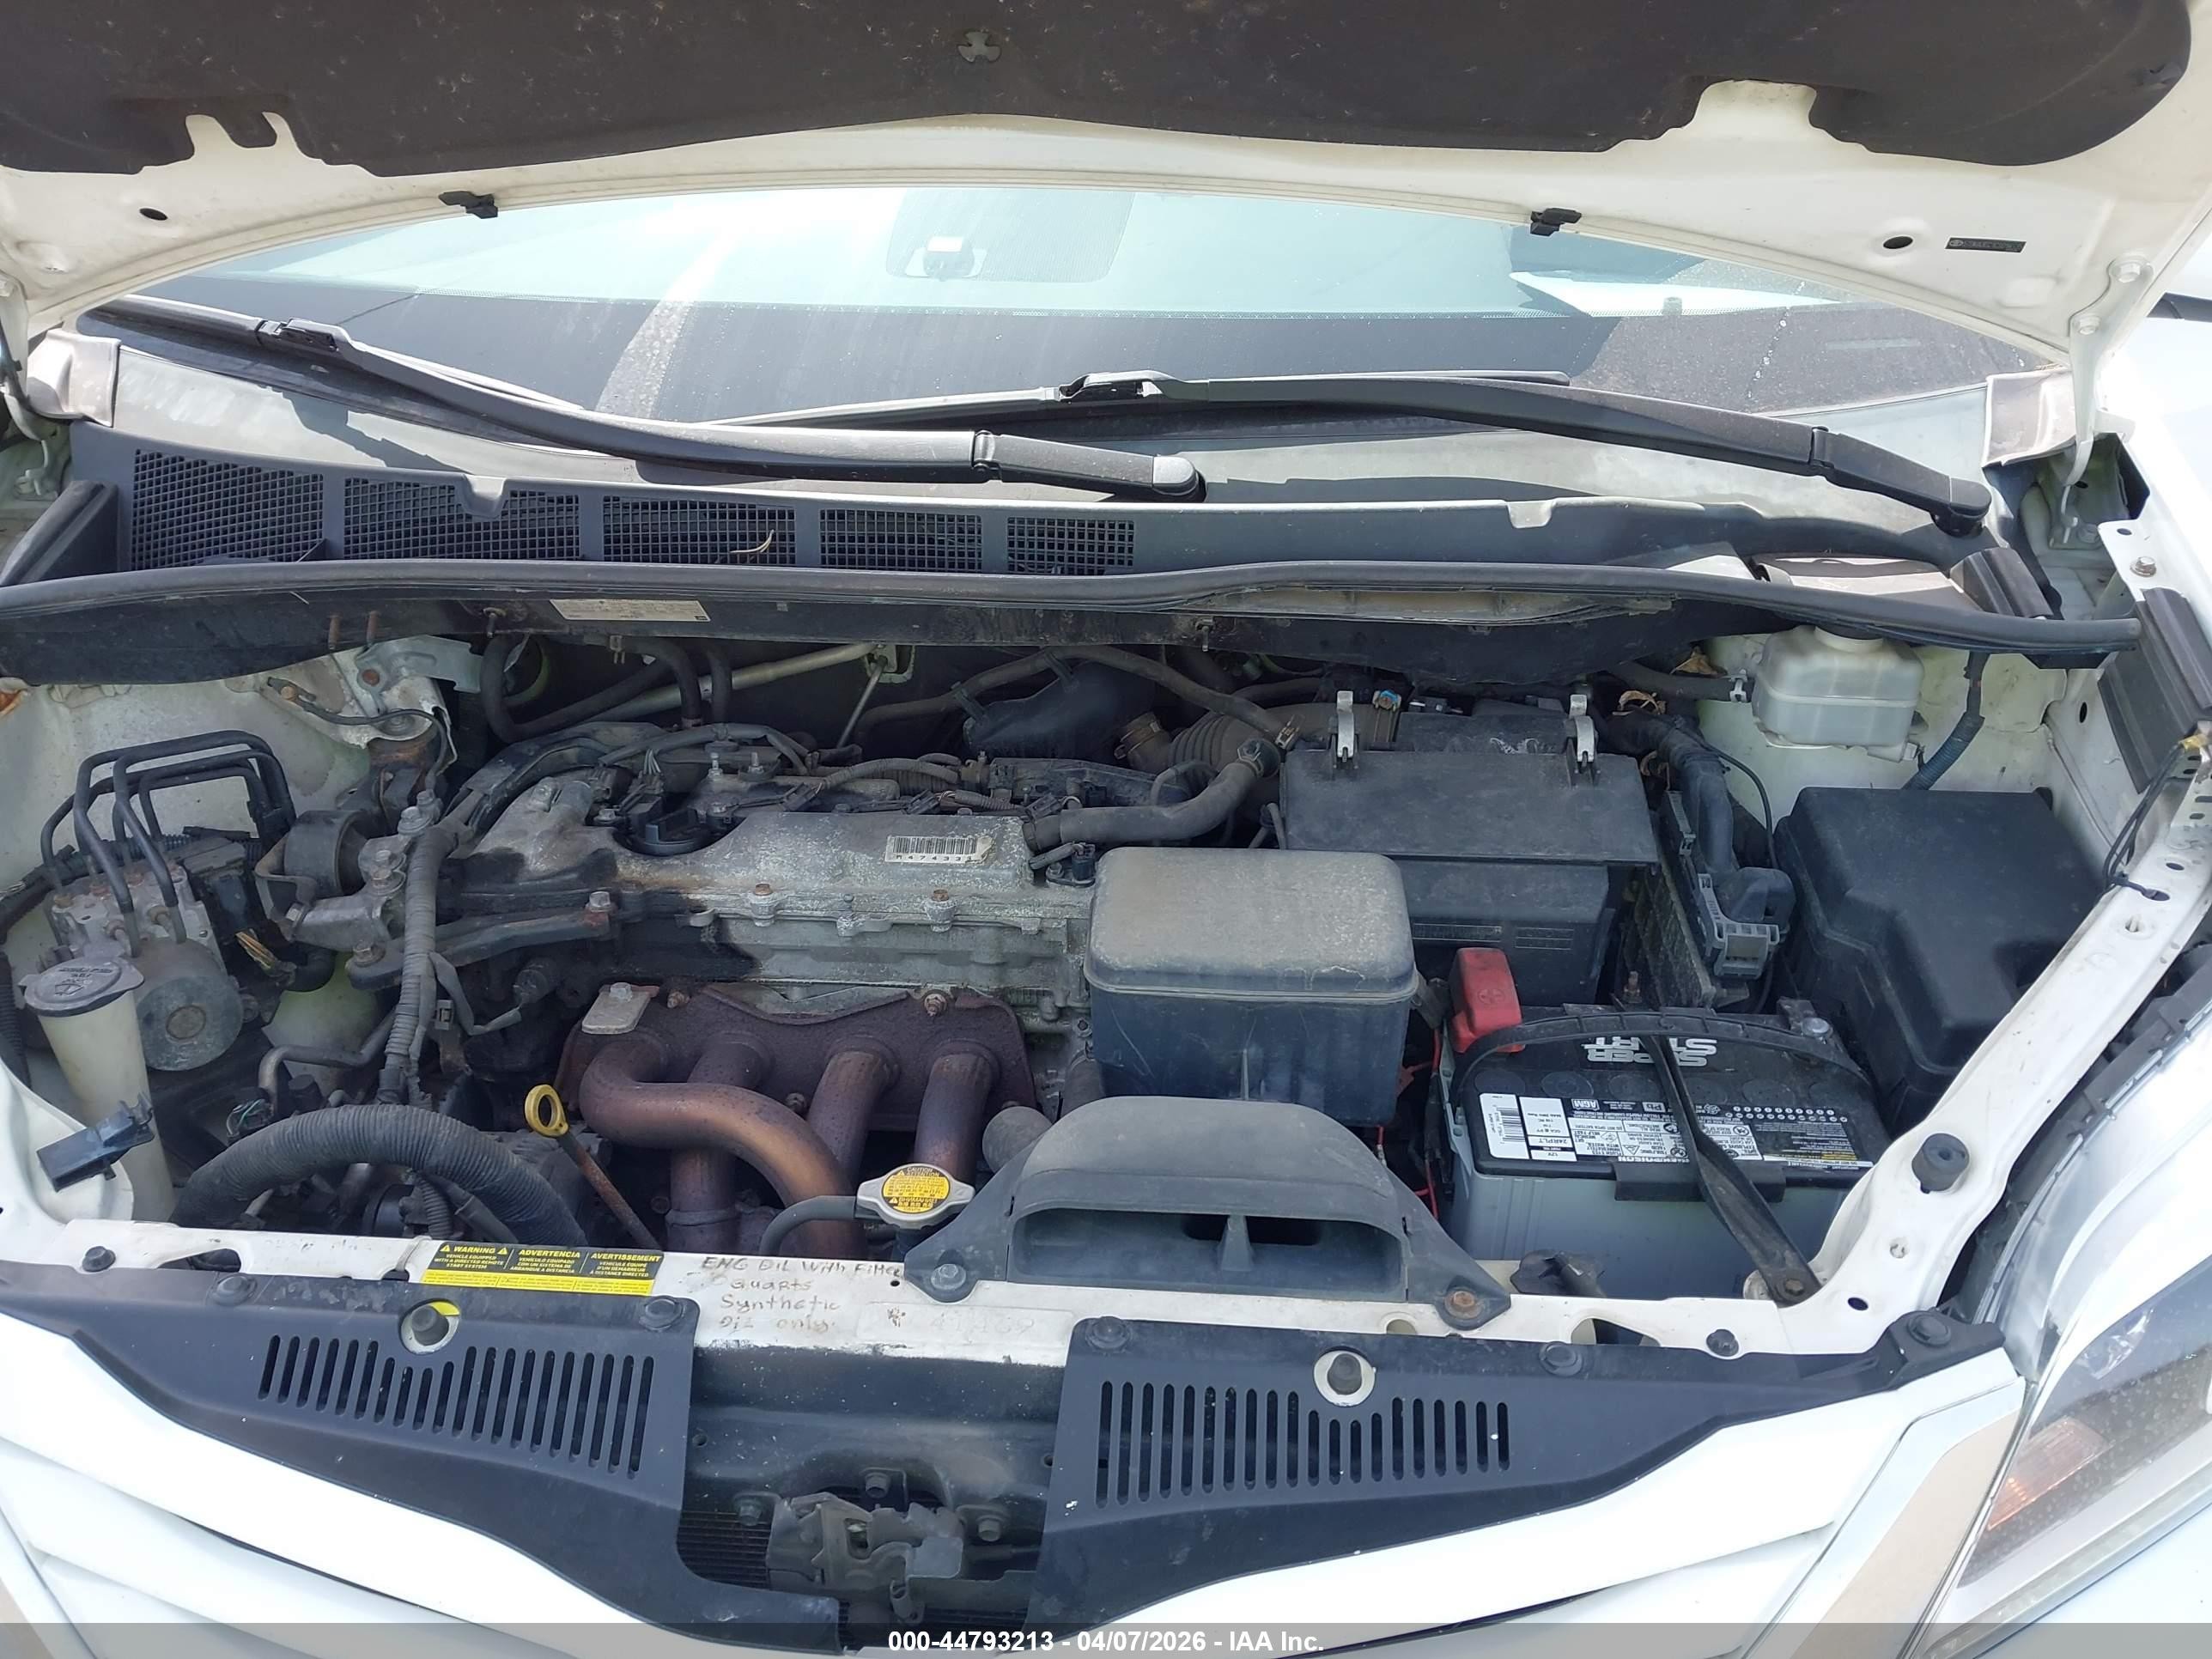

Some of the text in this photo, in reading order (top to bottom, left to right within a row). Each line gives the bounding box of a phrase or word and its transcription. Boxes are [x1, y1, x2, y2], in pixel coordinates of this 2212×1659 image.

[1582, 1036, 1717, 1055] STRT
[1588, 1049, 1708, 1066] SPER
[519, 1249, 581, 1259] ADVERTENCIA
[590, 1252, 663, 1262] AVERTISSEMENT
[701, 1256, 749, 1270] ENG
[720, 1294, 842, 1314] Synthetic
